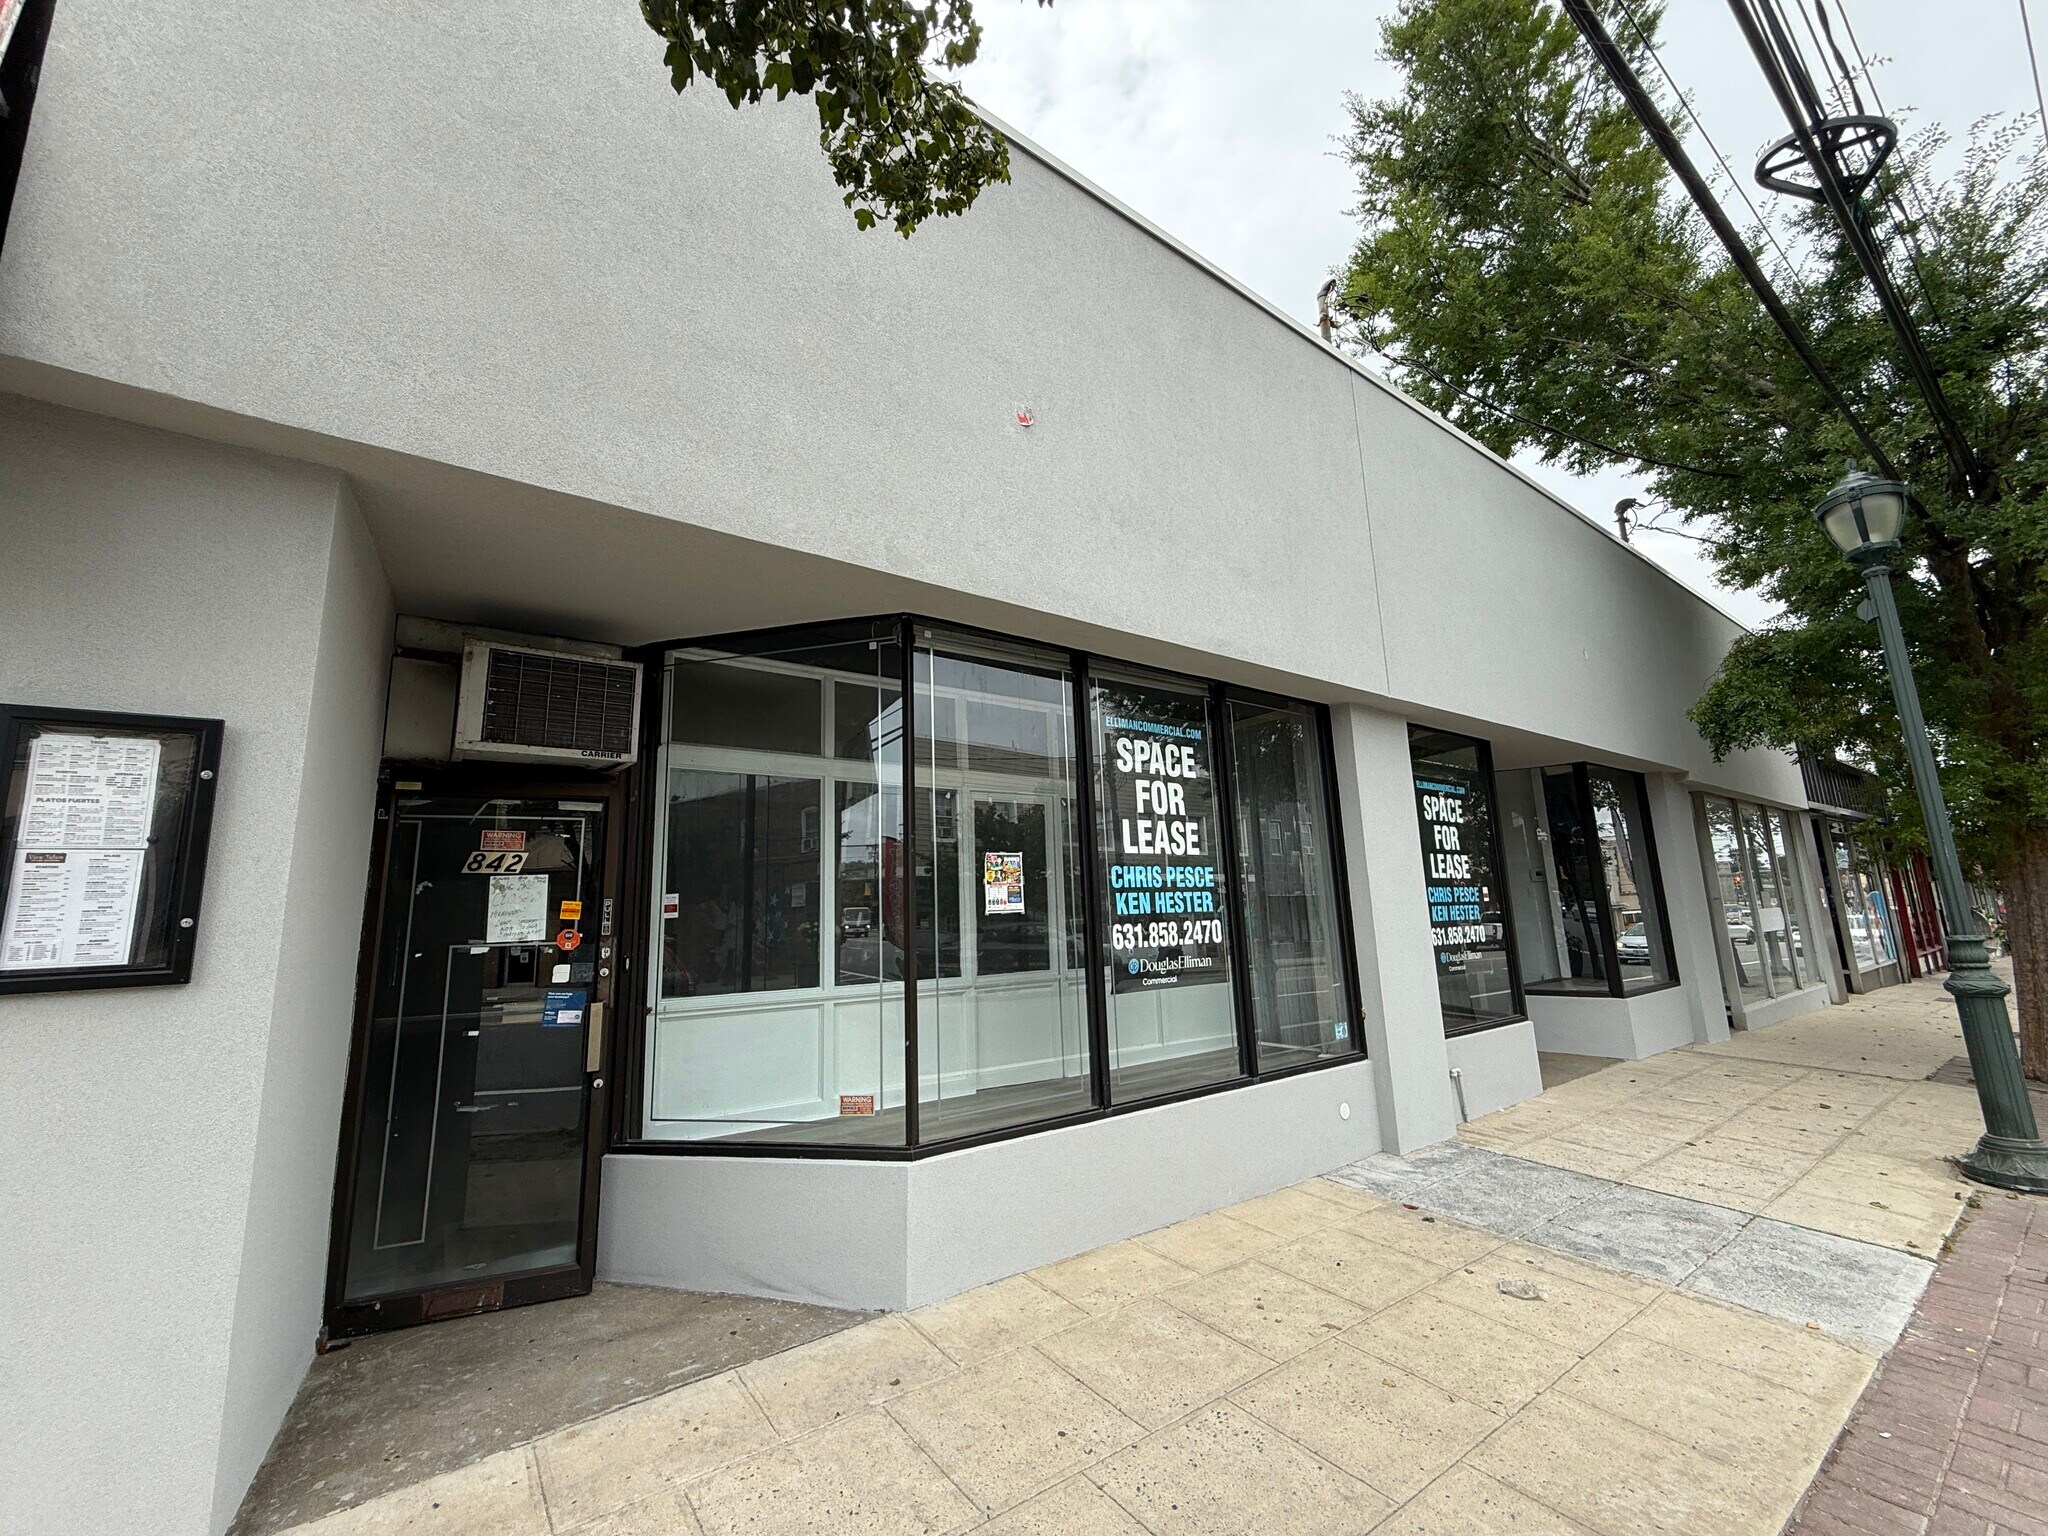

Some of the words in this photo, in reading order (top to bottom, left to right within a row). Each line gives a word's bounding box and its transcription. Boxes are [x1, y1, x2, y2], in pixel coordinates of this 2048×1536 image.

[1105, 716, 1202, 740] ELLIMANCOMMERCIAL.COM
[581, 750, 622, 759] CARRIER
[1116, 737, 1197, 779] SPACE
[1135, 779, 1186, 816] FOR
[1423, 794, 1464, 824] SPACE
[1122, 819, 1200, 856] LEASE
[1433, 824, 1461, 851] FOR
[466, 853, 523, 872] 842
[1429, 853, 1471, 879] LEASE
[1110, 865, 1163, 888] CHRIS
[1165, 866, 1215, 888] PESCE
[1115, 892, 1151, 915] KEN
[1154, 891, 1214, 914] HESTER
[1427, 886, 1452, 903] CHRIS
[1453, 886, 1480, 903] PESCE
[1431, 905, 1448, 922] KEN
[1449, 904, 1480, 921] HESTER
[1112, 919, 1223, 950] 631.858.2470
[1431, 925, 1486, 947] 631.858.2470
[1142, 975, 1178, 986] Commercial
